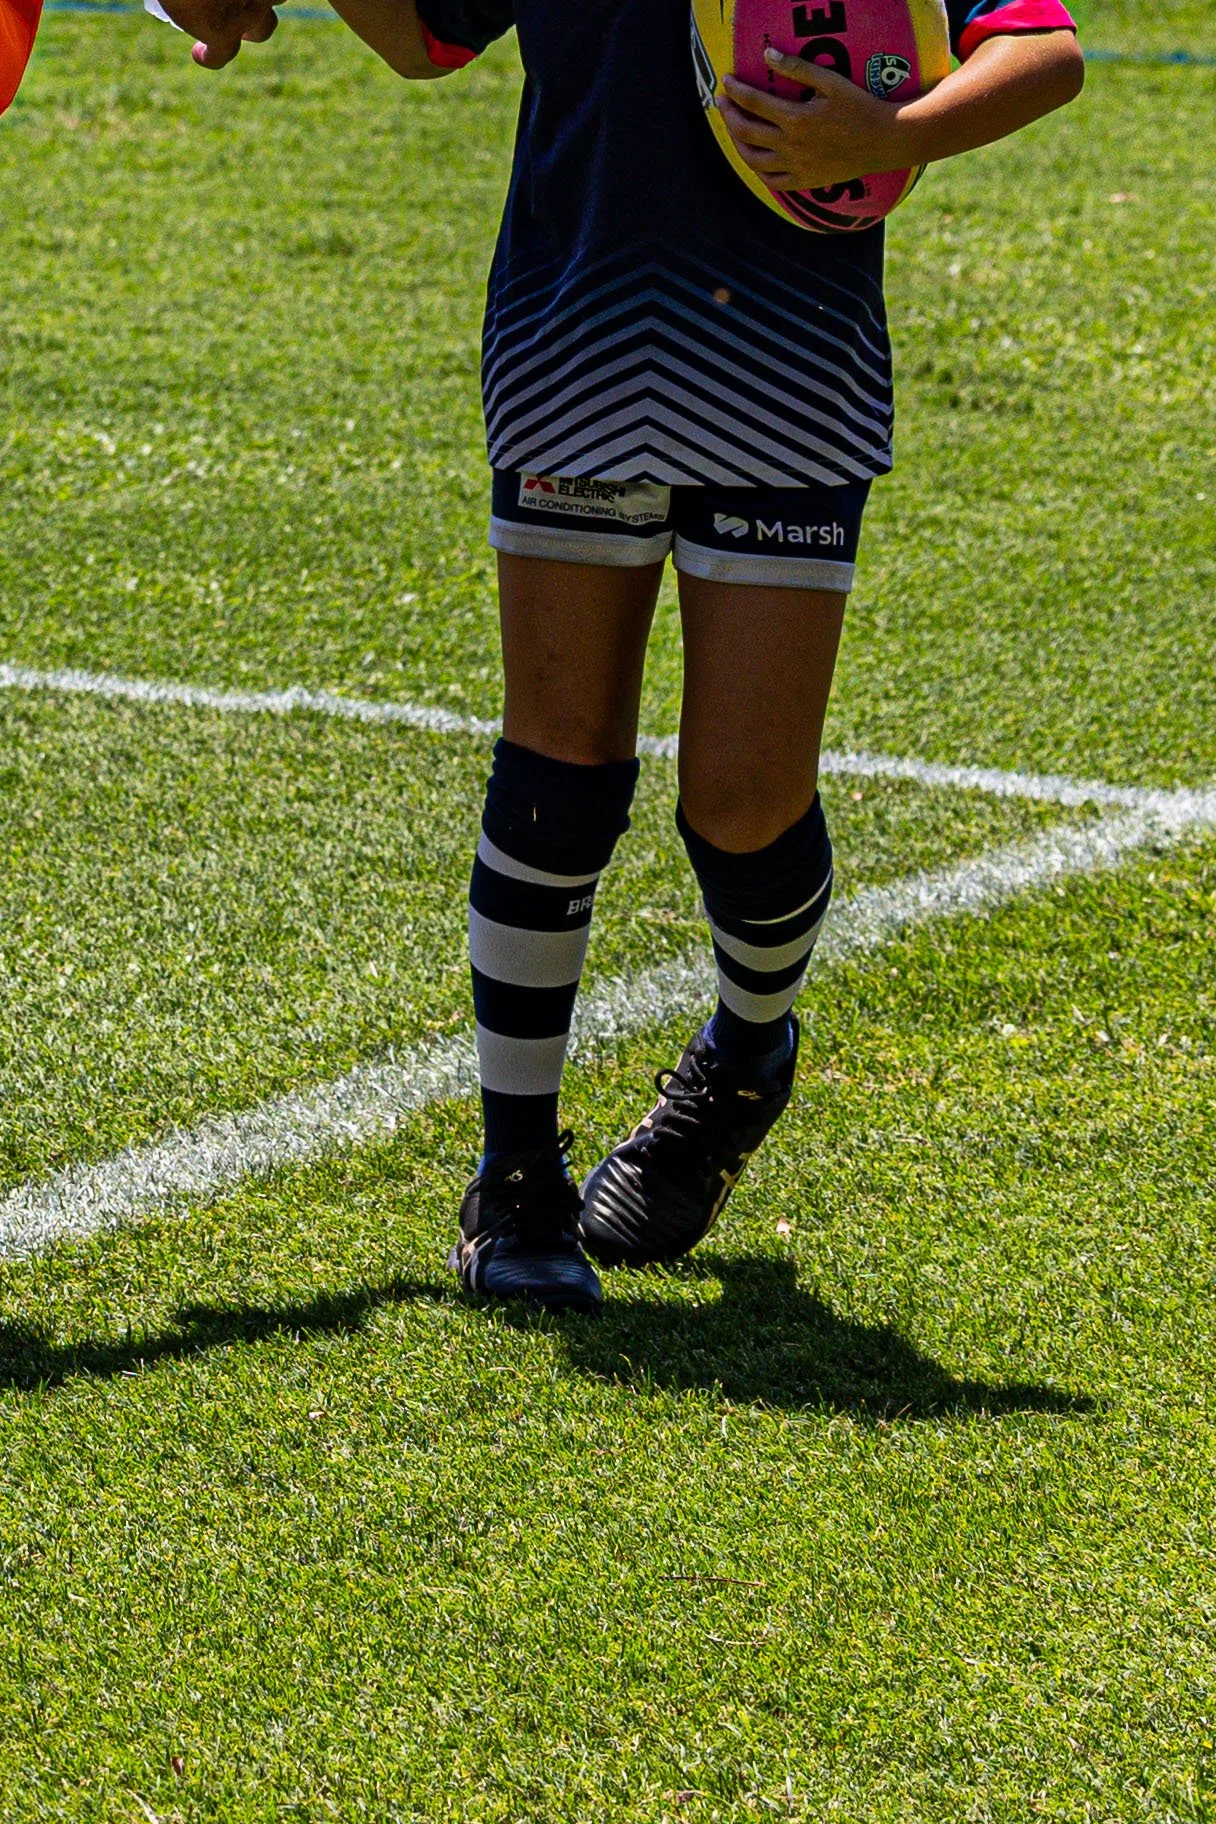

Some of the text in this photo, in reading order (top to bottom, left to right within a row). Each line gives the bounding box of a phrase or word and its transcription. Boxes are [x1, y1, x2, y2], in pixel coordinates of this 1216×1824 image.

[558, 484, 616, 504] ELECTRIC
[522, 495, 537, 507] AIR
[539, 498, 617, 517] CONDITIONING
[755, 518, 845, 547] Marsh
[566, 895, 593, 916] BR
